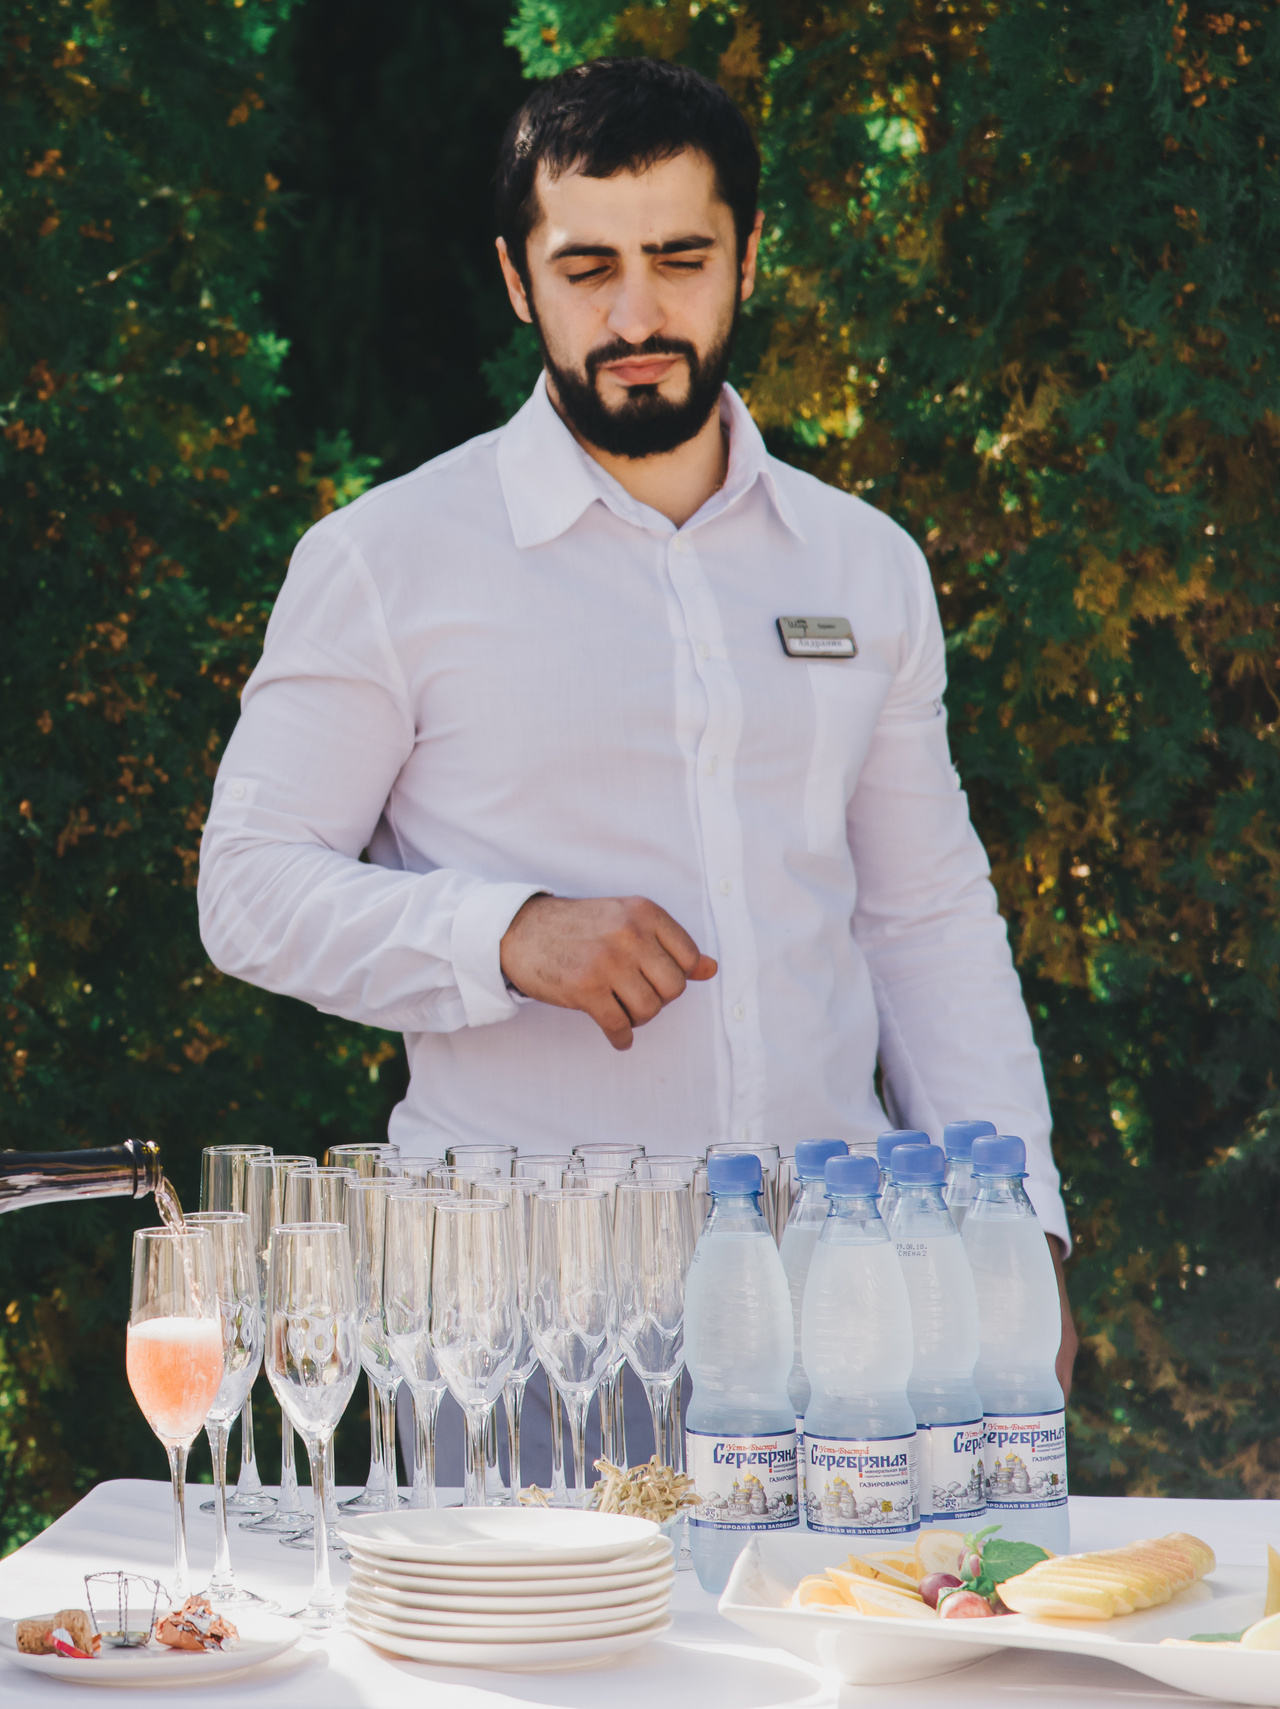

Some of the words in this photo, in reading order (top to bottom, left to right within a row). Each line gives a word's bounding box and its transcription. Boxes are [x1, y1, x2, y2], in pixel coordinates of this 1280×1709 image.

[810, 1444, 907, 1472] Серебряная
[859, 1479, 909, 1488] ГАЗИРОВАННАЯ
[713, 1522, 756, 1530] ПРИРОДНАЯ
[812, 1525, 845, 1534] ПРИРОДНАЯ
